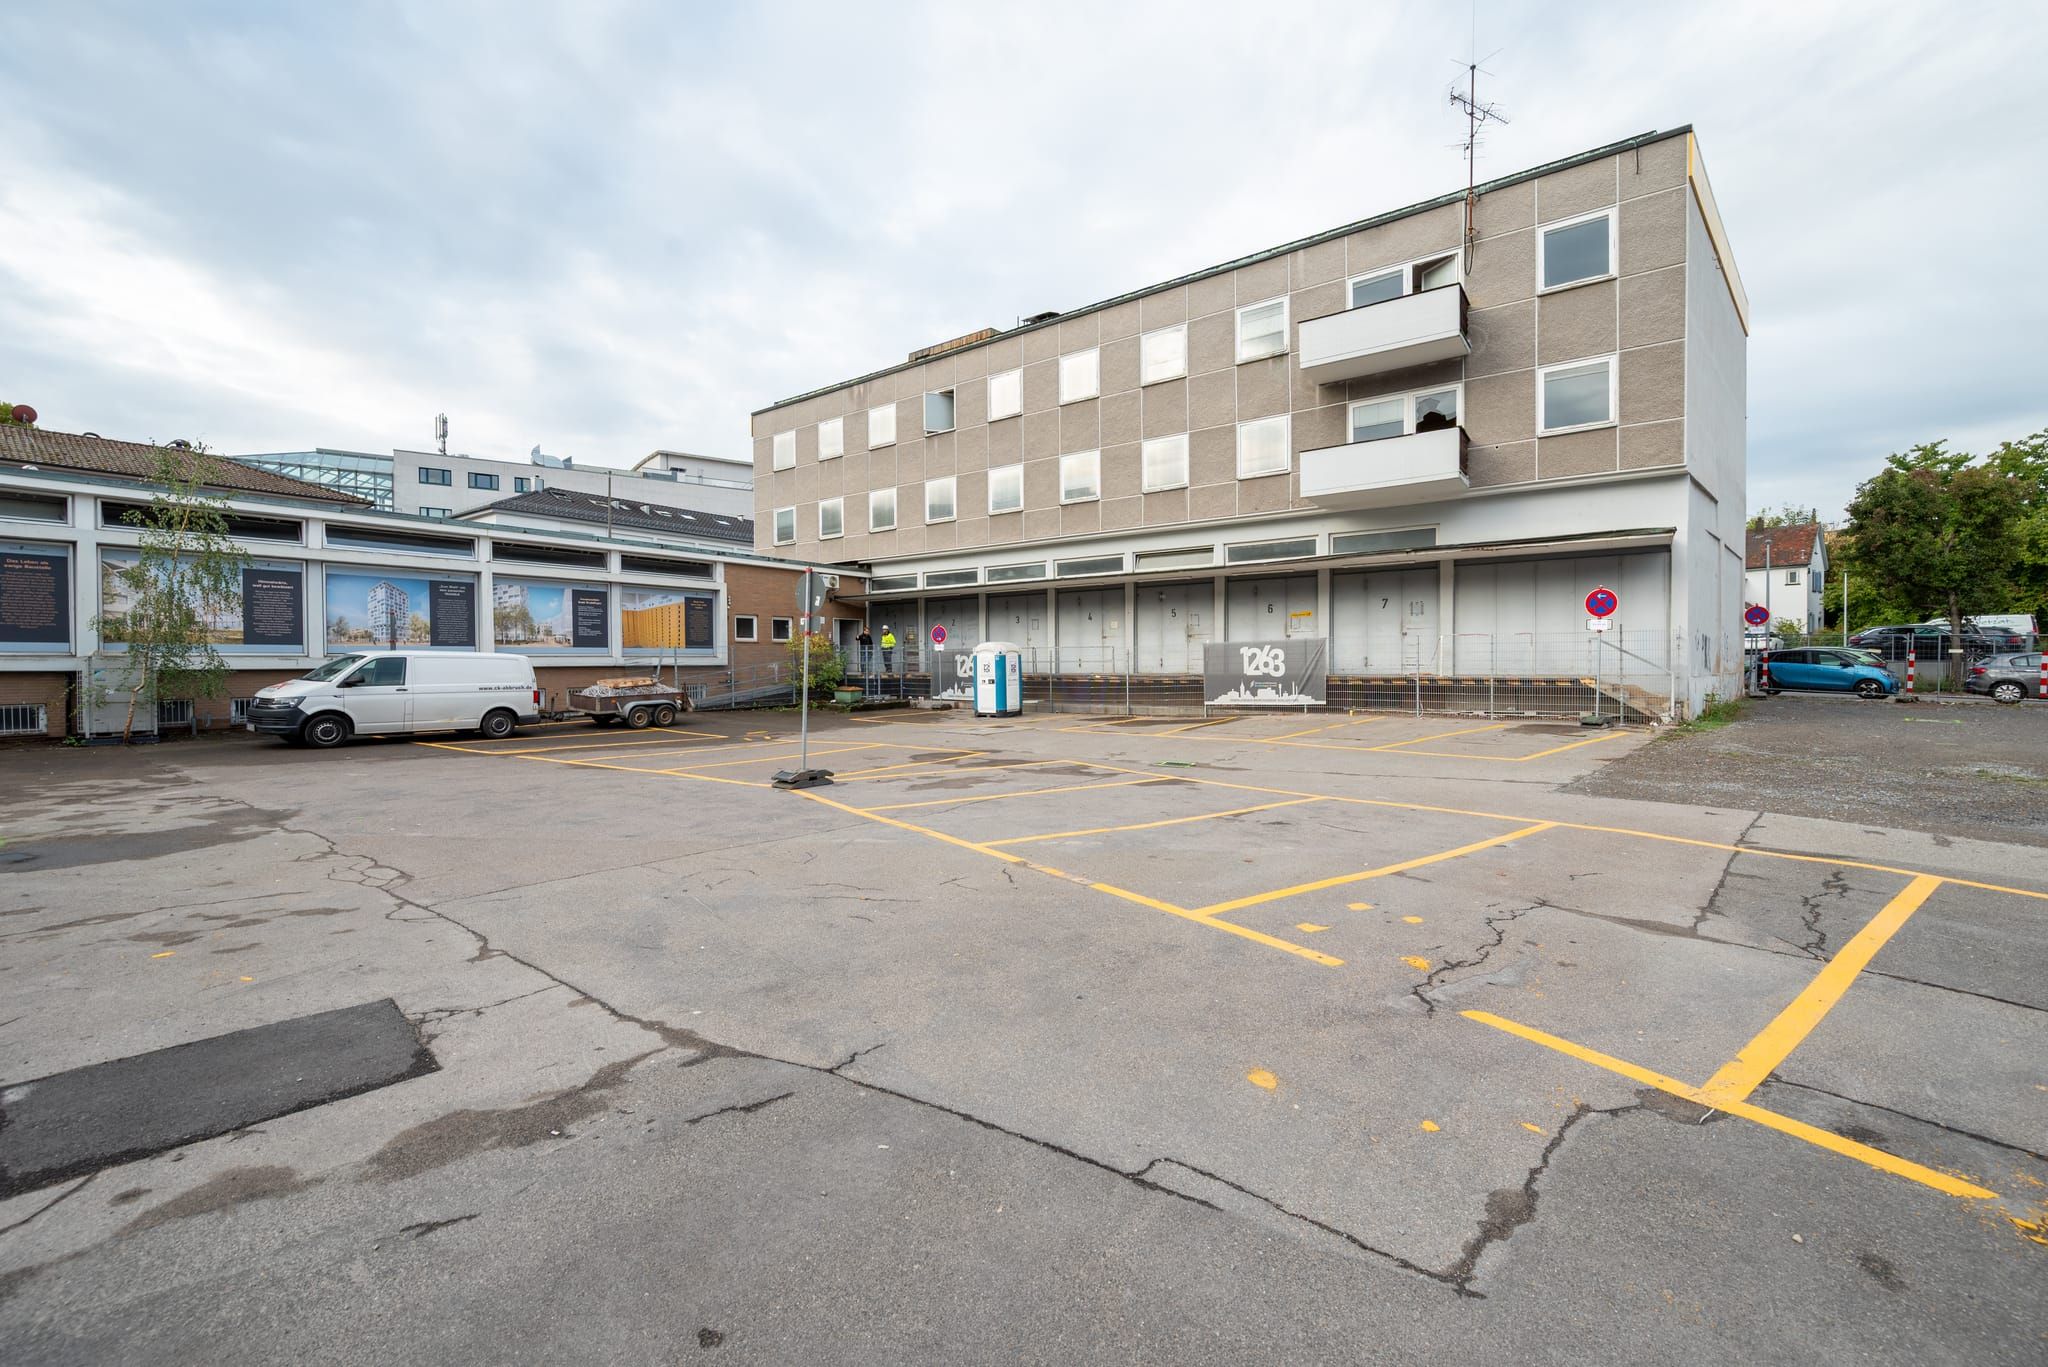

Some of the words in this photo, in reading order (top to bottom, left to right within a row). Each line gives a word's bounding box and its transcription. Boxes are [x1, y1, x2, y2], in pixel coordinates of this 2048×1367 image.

[1382, 598, 1389, 609] 7
[1171, 608, 1177, 617] 5
[1267, 604, 1273, 613] 6
[1015, 615, 1021, 624] 3
[1087, 612, 1093, 621] 4
[955, 653, 975, 678] 126
[1240, 645, 1286, 677] 1263
